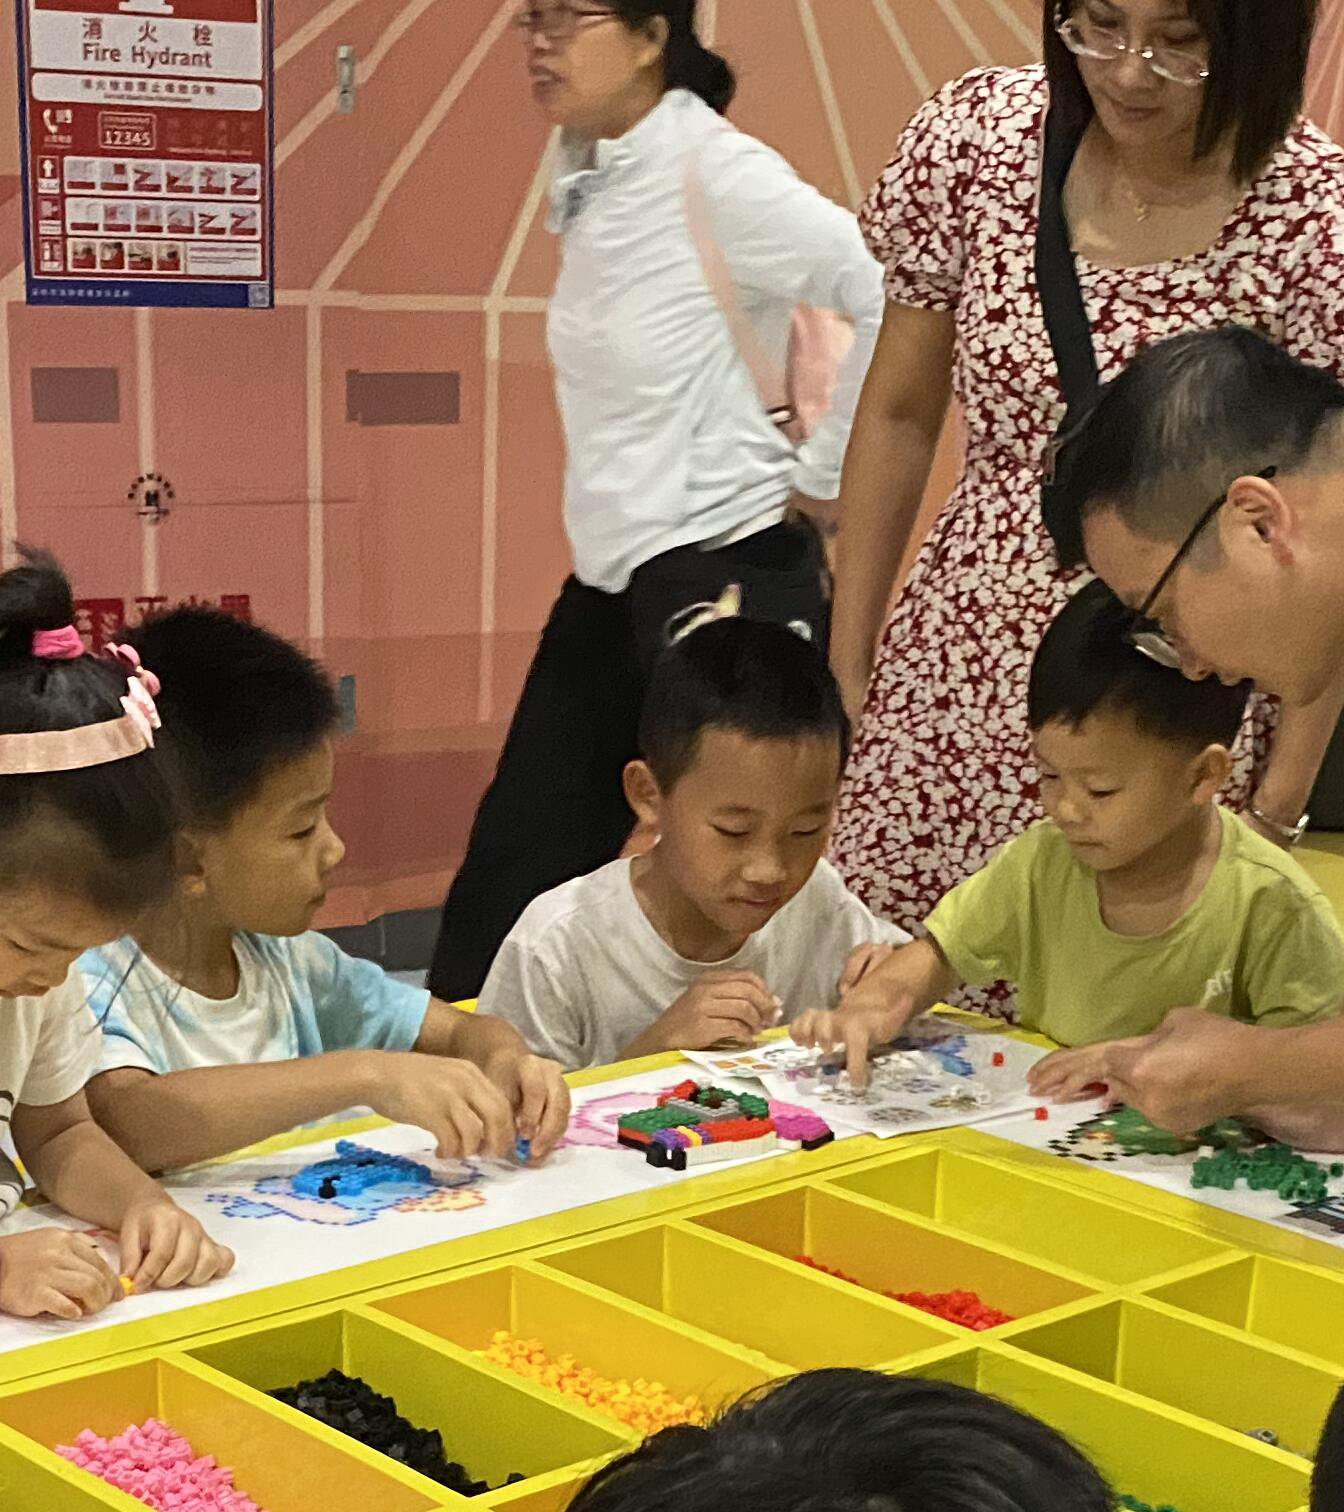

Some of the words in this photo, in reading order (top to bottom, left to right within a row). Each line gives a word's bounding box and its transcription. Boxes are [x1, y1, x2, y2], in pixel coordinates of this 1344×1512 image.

[82, 17, 213, 46] 消火栓
[83, 42, 121, 62] Fire
[131, 45, 213, 69] Hydrant
[104, 131, 151, 147] 12345
